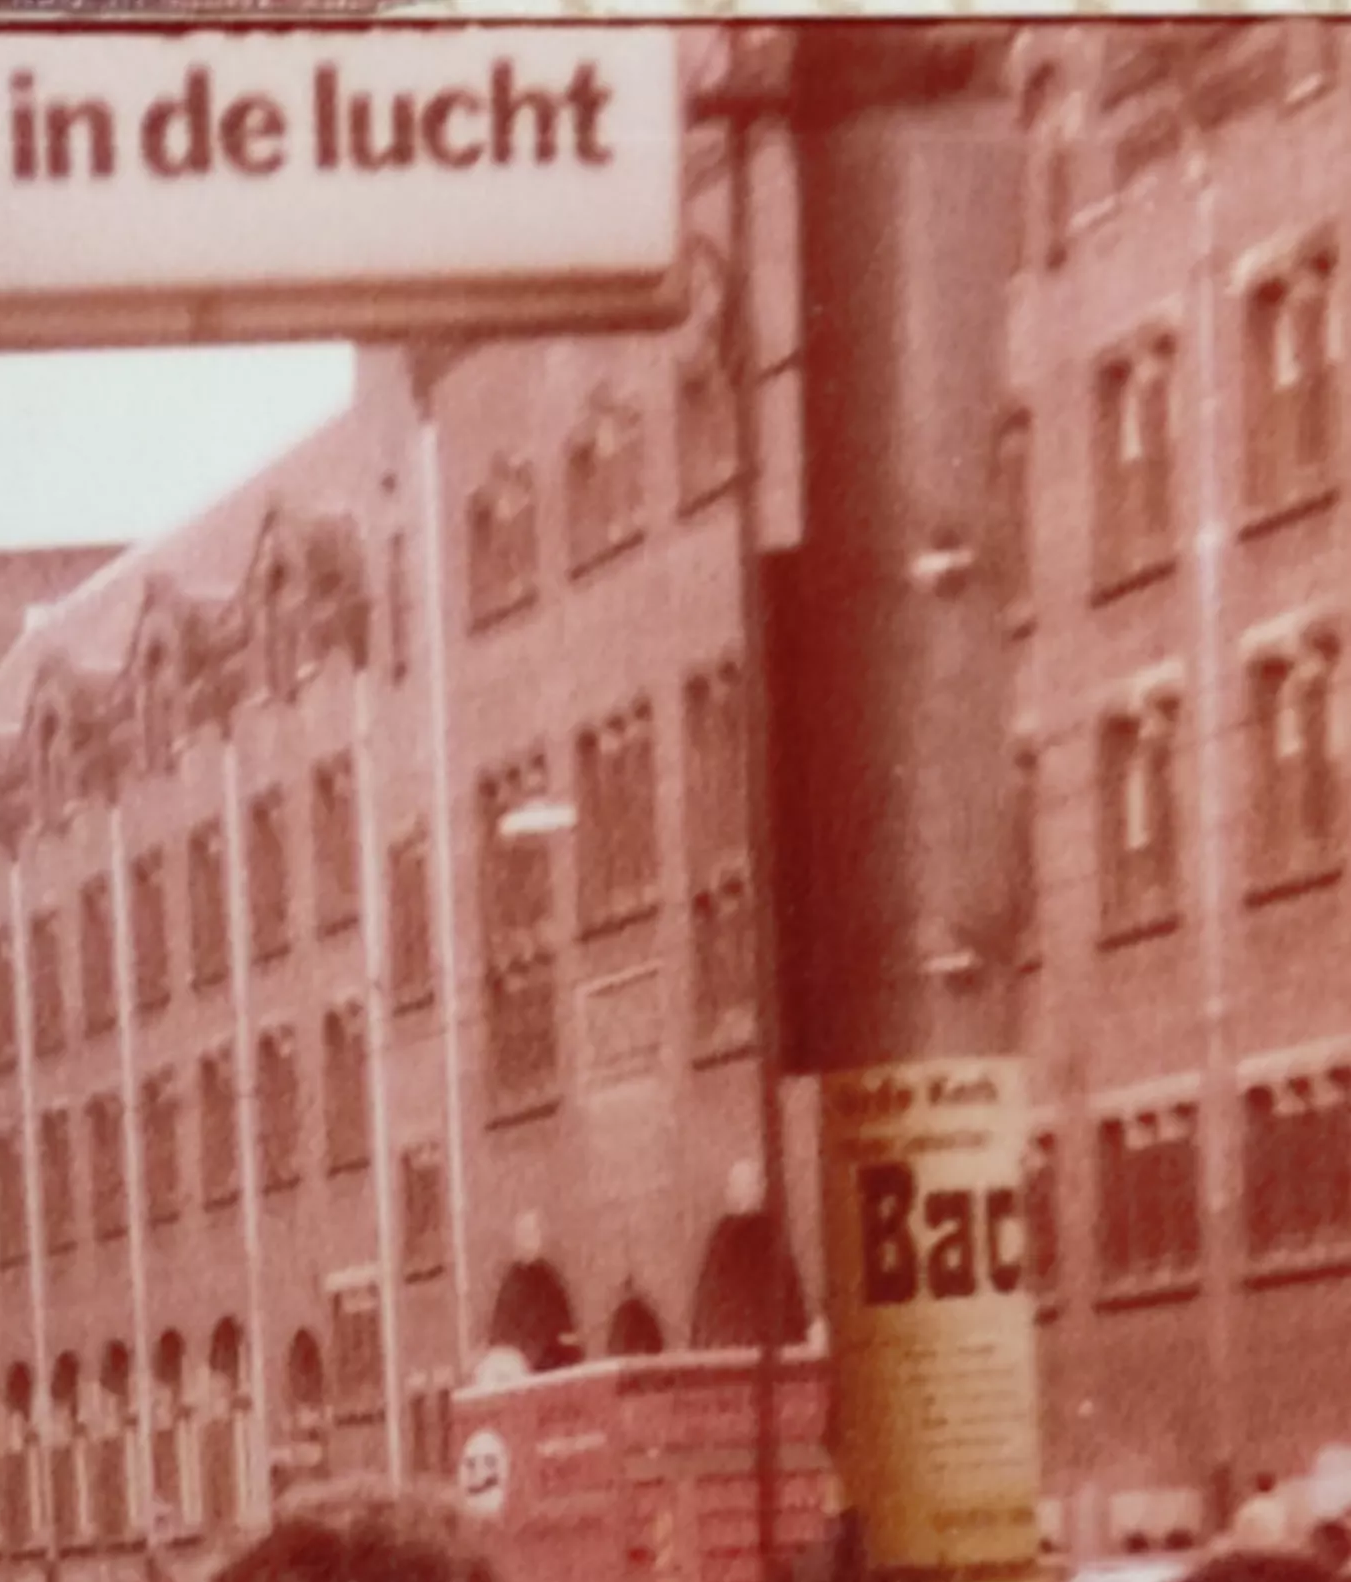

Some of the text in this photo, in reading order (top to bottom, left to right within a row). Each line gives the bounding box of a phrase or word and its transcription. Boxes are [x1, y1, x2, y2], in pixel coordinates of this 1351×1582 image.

[9, 58, 613, 180] in de lucht
